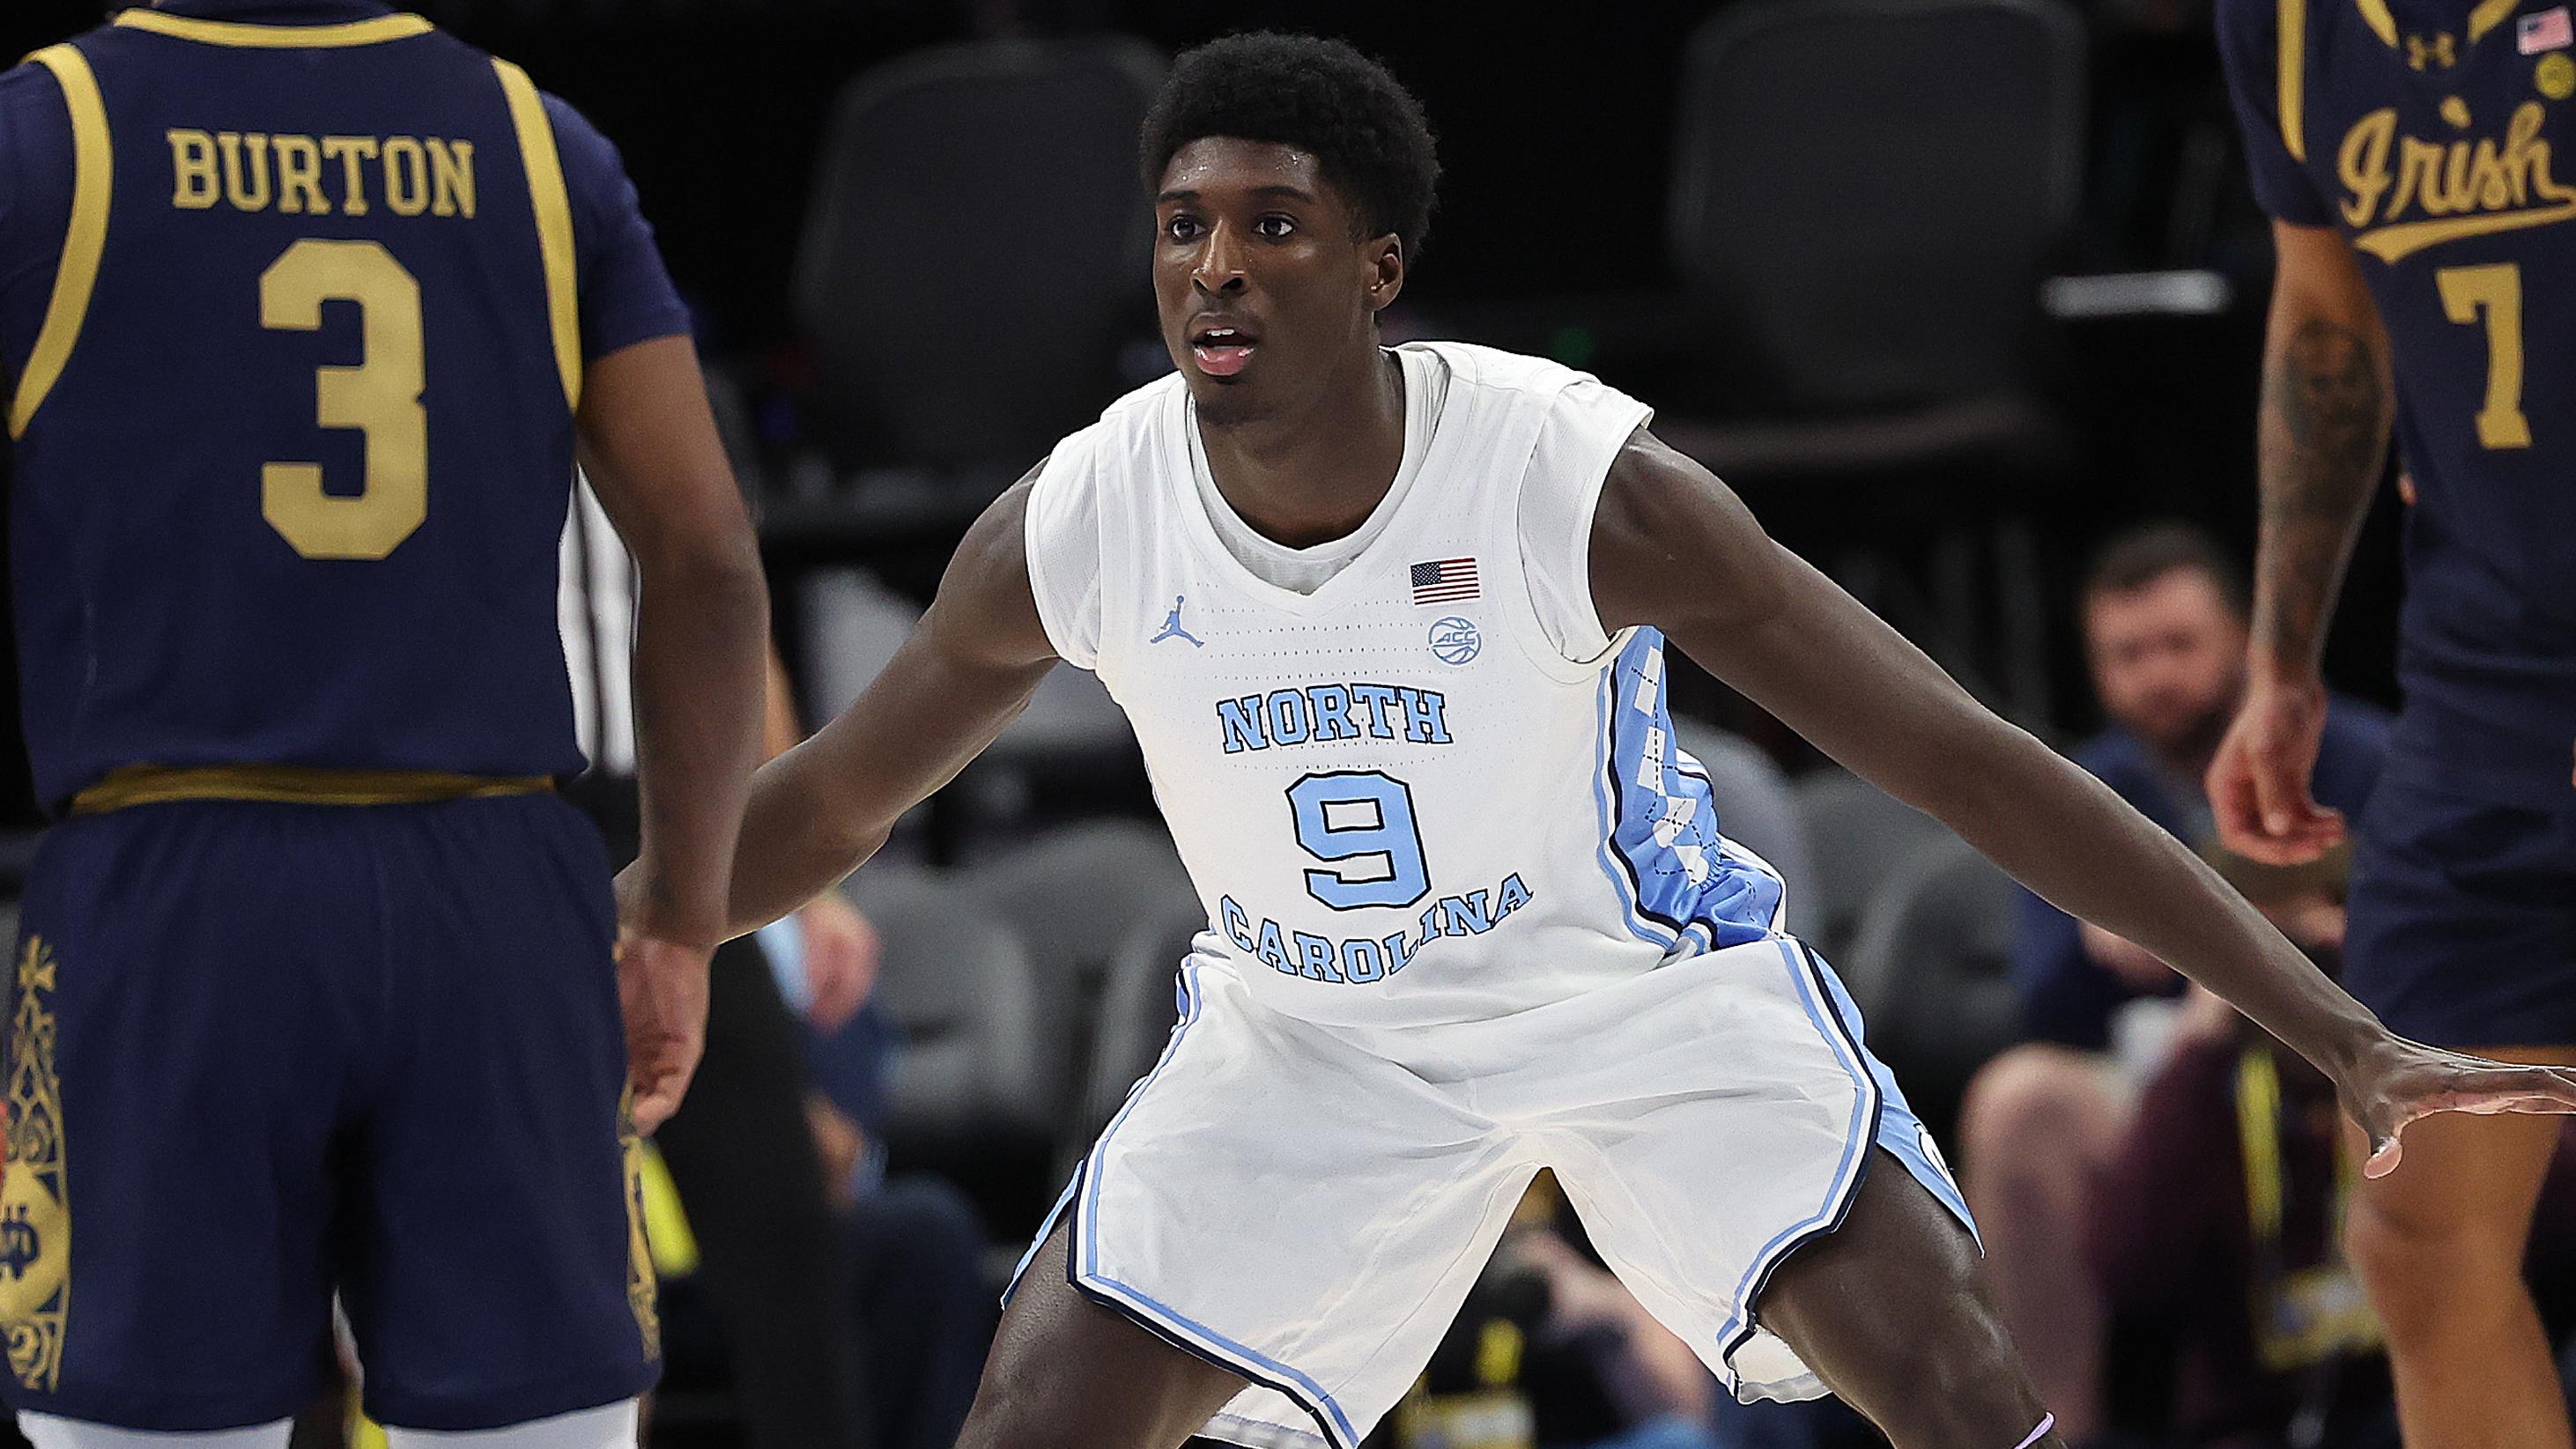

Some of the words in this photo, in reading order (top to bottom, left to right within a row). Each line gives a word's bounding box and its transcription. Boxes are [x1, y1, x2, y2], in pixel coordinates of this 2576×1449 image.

[167, 129, 475, 218] BURTON
[2337, 95, 2576, 228] Irish
[261, 240, 428, 560] 3
[2436, 264, 2532, 448] 7
[1436, 630, 1477, 644] ACC
[1217, 684, 1453, 754] NORTH
[1285, 771, 1432, 911] 9
[1220, 873, 1534, 984] CAROLINA
